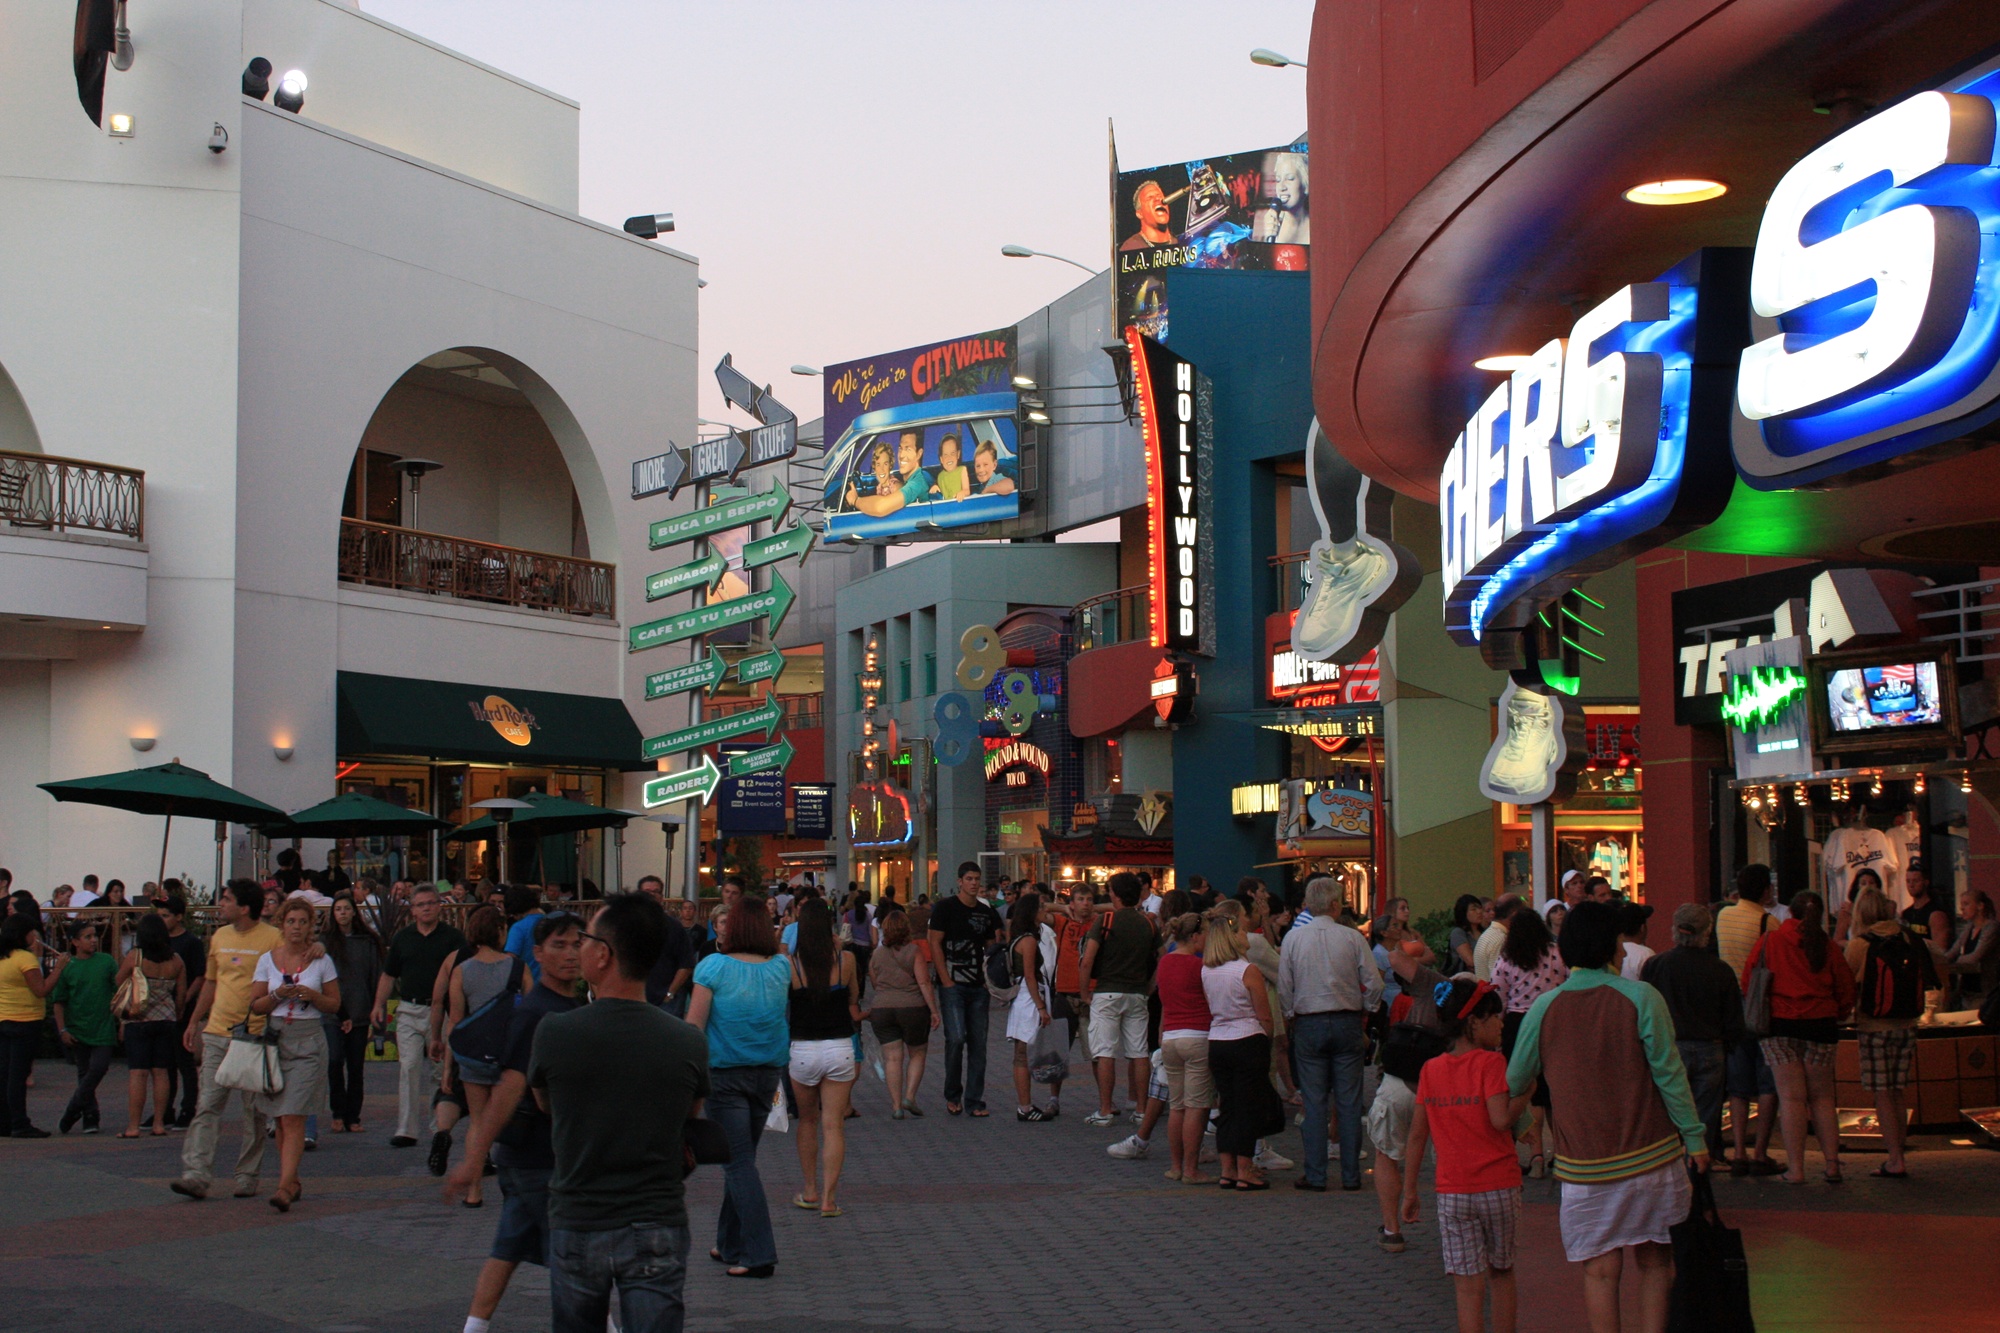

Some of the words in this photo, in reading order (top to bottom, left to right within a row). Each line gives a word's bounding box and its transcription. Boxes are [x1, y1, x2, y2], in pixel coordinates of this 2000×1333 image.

[1121, 251, 1149, 274] L.A.
[1152, 244, 1198, 269] ROCKS
[831, 363, 875, 404] We're
[859, 366, 893, 411] Goin'
[893, 367, 907, 383] to
[910, 339, 1008, 396] CITYWALK
[757, 424, 787, 460] STUFF
[698, 441, 729, 476] GREAT
[639, 459, 666, 492] MORE
[1174, 362, 1197, 637] HOLLYWOOD
[658, 518, 700, 537] BUCA
[705, 512, 722, 523] DI
[727, 497, 779, 518] BEPPO
[764, 540, 790, 555] IFLY
[652, 562, 719, 590] CINNABON
[637, 625, 673, 641] CAFE
[677, 617, 697, 629] TU
[701, 611, 719, 623] TU
[724, 596, 777, 617] TANGO
[651, 661, 714, 684] WETZEL'S
[750, 660, 769, 671] STOP
[755, 664, 773, 674] PLAY
[1678, 632, 1779, 698] TE
[655, 671, 716, 694] PRETZELS
[467, 701, 504, 722] Hard
[501, 704, 542, 730] Rock
[504, 727, 524, 737] CAFE
[652, 730, 701, 751] JILLIAN'S
[703, 726, 716, 737] HI
[718, 720, 740, 733] LIFE
[742, 710, 776, 726] LANES
[742, 749, 780, 765] SALVATORY
[750, 757, 772, 768] SHOES
[984, 744, 1013, 781] WOUND
[1012, 742, 1020, 761] &
[1019, 742, 1049, 772] WOUND
[657, 775, 710, 797] RAIDERS
[1006, 772, 1016, 786] TOY
[1320, 791, 1383, 812] CARTOO
[1342, 806, 1363, 820] OF
[1328, 811, 1371, 833] YOU
[1423, 1095, 1480, 1107] WILLIAMS
